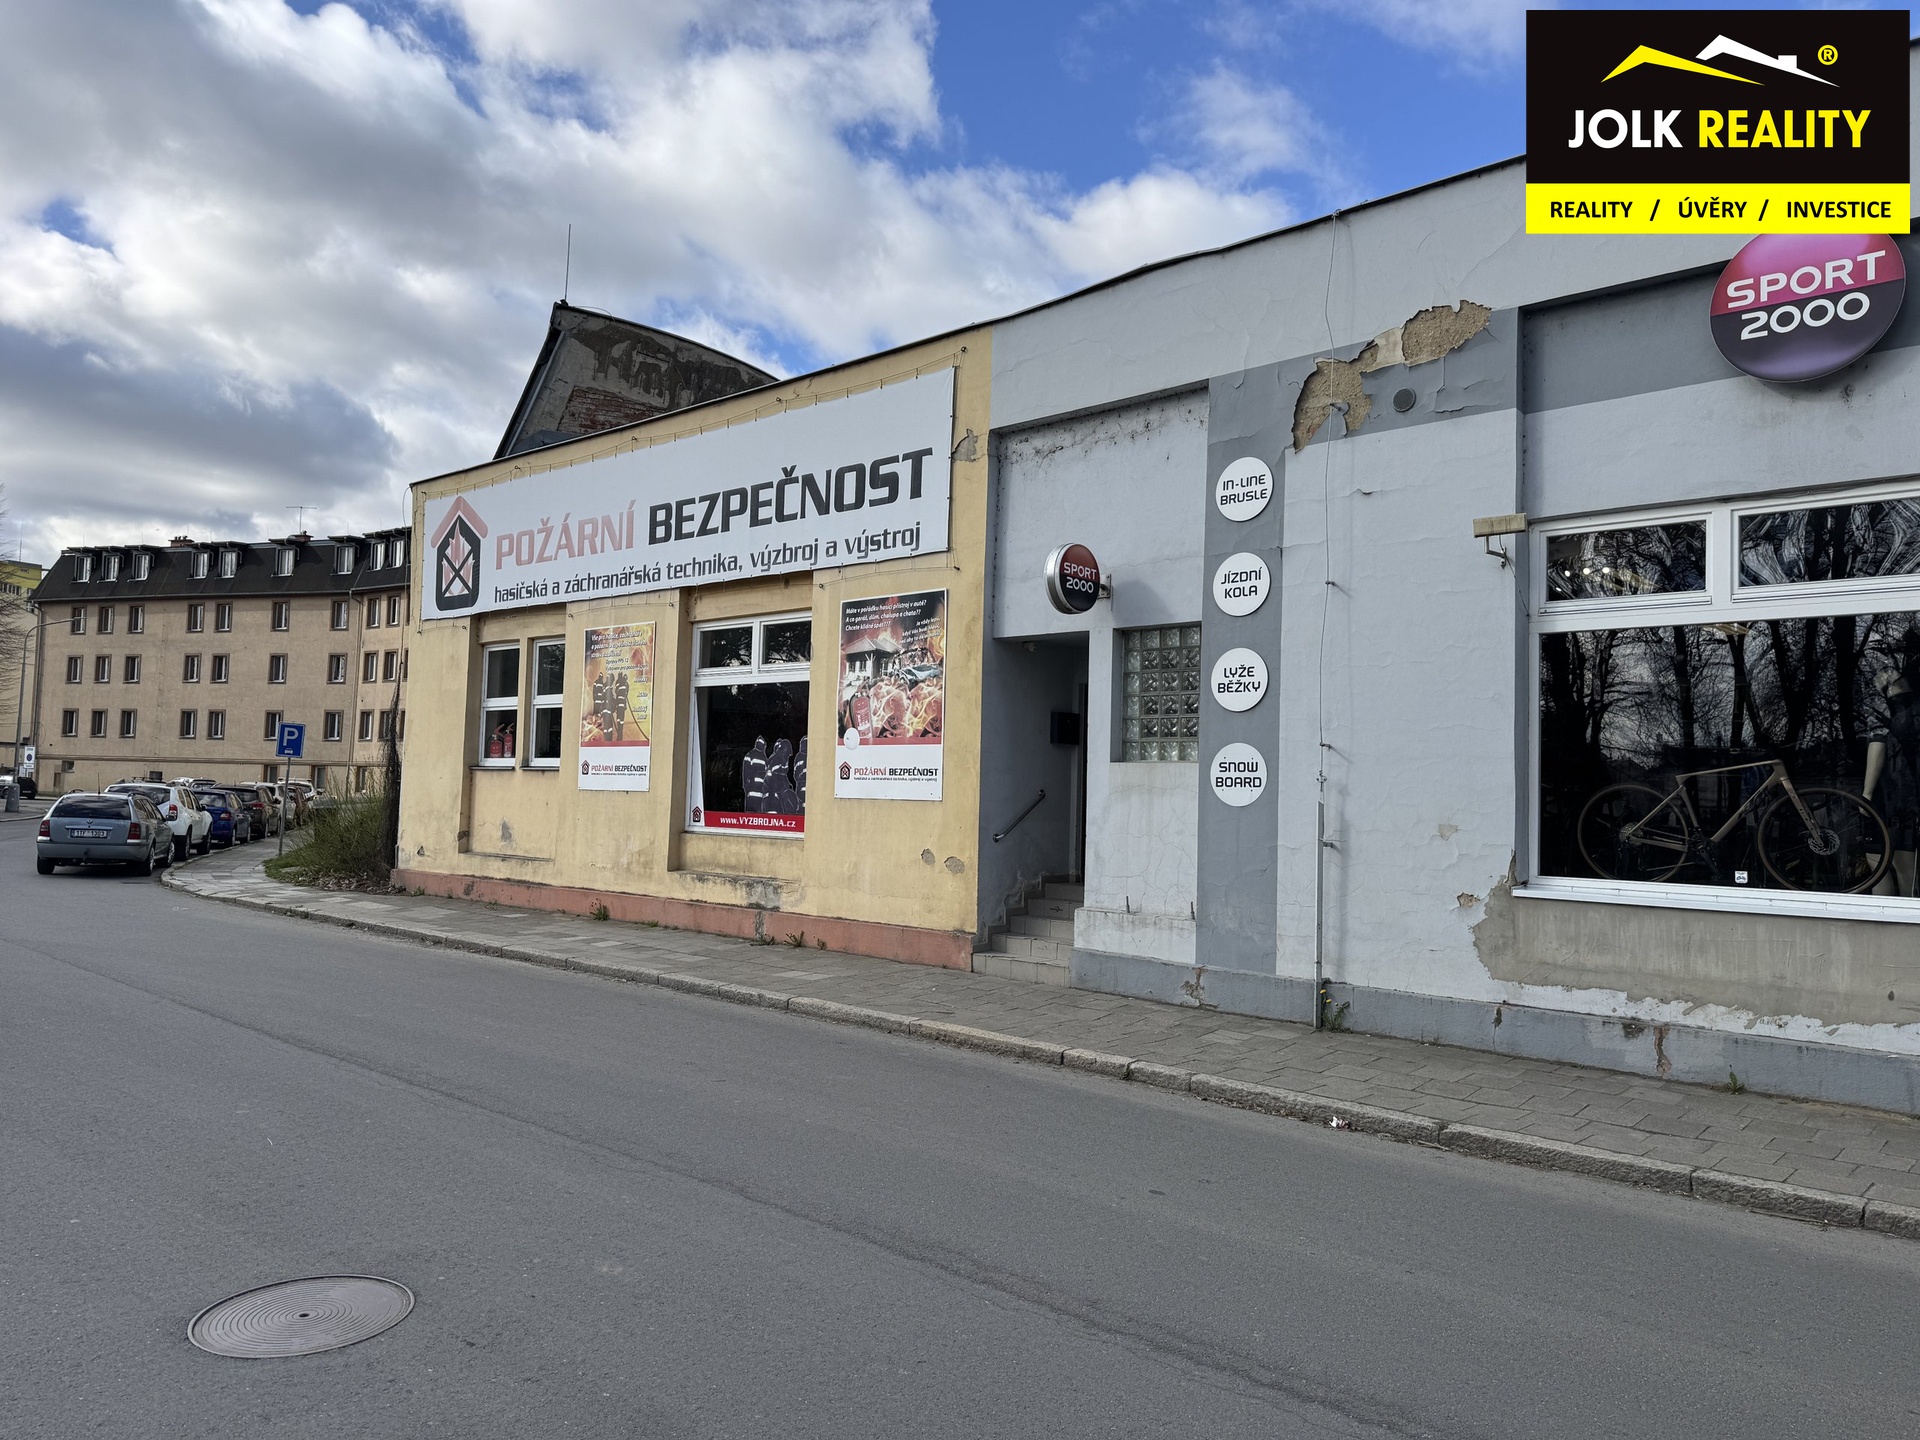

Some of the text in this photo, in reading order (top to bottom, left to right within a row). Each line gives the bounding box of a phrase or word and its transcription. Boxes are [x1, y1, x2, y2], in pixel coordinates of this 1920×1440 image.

[1726, 250, 1886, 309] SPORT
[1740, 292, 1870, 341] 2000
[1222, 474, 1266, 491] IN-LINE
[1220, 488, 1268, 506] BRUSLE
[496, 447, 933, 570] POŽÁRNÍ BEZPEČNOST
[494, 521, 921, 603] hasičská a záchranářská technika, výzbroj a výstroj
[1064, 562, 1097, 580] SPORT
[1221, 566, 1263, 584] JÍZDNÍ
[1066, 577, 1094, 593] 2000
[1224, 585, 1258, 599] KOLA
[1223, 664, 1255, 678] LYŽE
[1217, 679, 1261, 693] BĚŽKY
[283, 727, 299, 746] P
[614, 764, 648, 772] BEZPEČNOST
[854, 766, 938, 776] POŽÁRNÍ BEZPEČNOST
[1219, 761, 1258, 773] SNOW
[1215, 777, 1262, 788] BOARD
[720, 816, 796, 828] www.VYZBROJNA.cz
